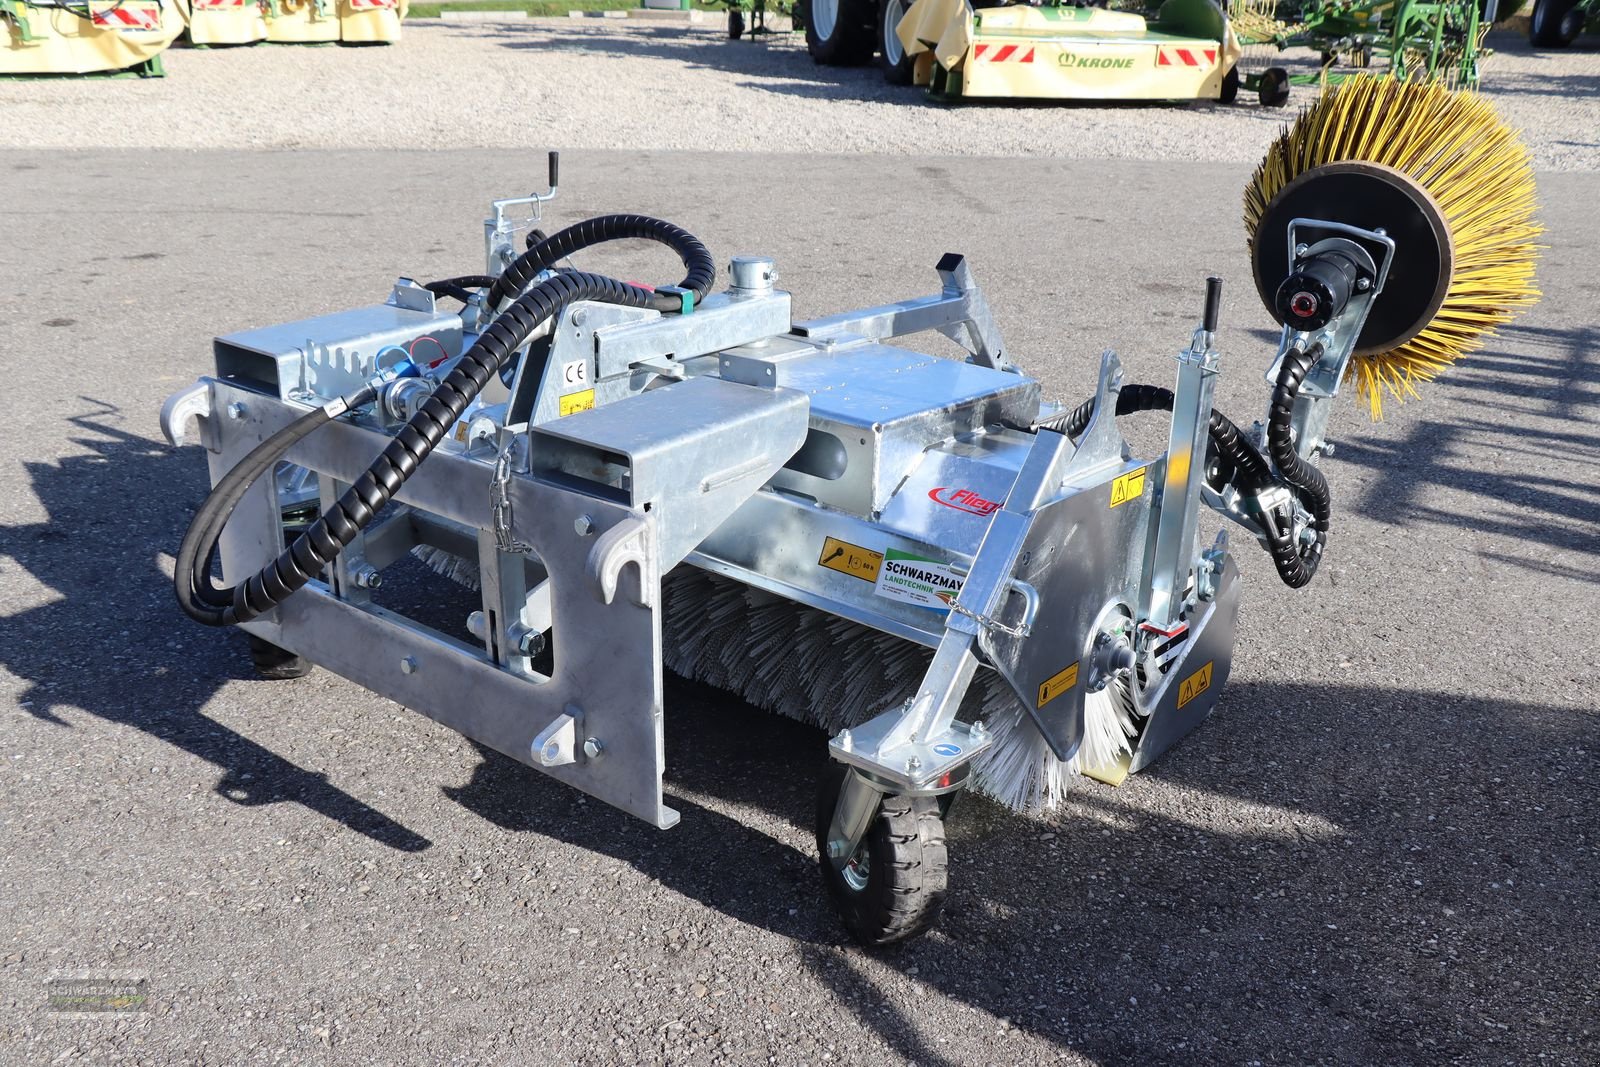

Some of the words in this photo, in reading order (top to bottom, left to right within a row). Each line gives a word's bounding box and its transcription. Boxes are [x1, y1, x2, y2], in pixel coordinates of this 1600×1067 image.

[1076, 57, 1135, 68] KRONE
[566, 363, 583, 382] CE
[884, 574, 934, 593] LANDTECHNIK
[885, 561, 964, 591] SCHWARZMAY
